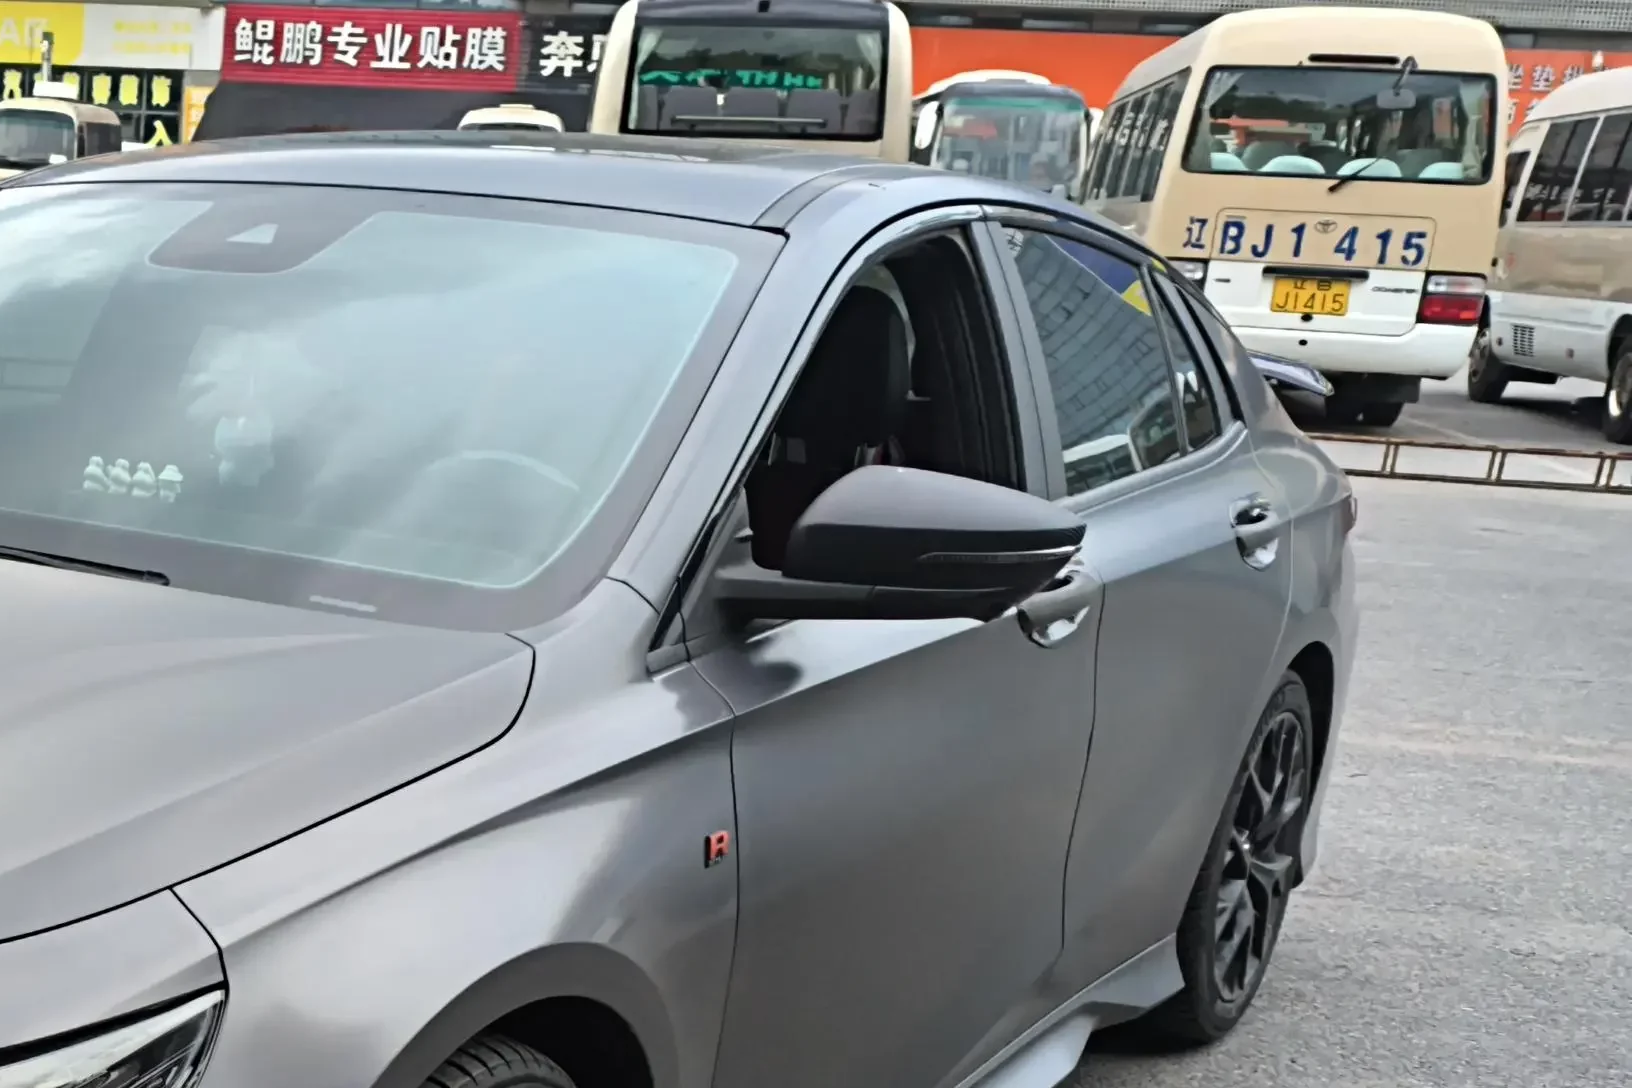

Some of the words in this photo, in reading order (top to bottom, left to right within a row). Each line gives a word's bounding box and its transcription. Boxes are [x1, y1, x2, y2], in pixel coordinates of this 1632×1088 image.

[234, 18, 508, 71] 鲲鹏专业贴膜
[1275, 292, 1345, 313] J1415
[704, 830, 730, 867] R
